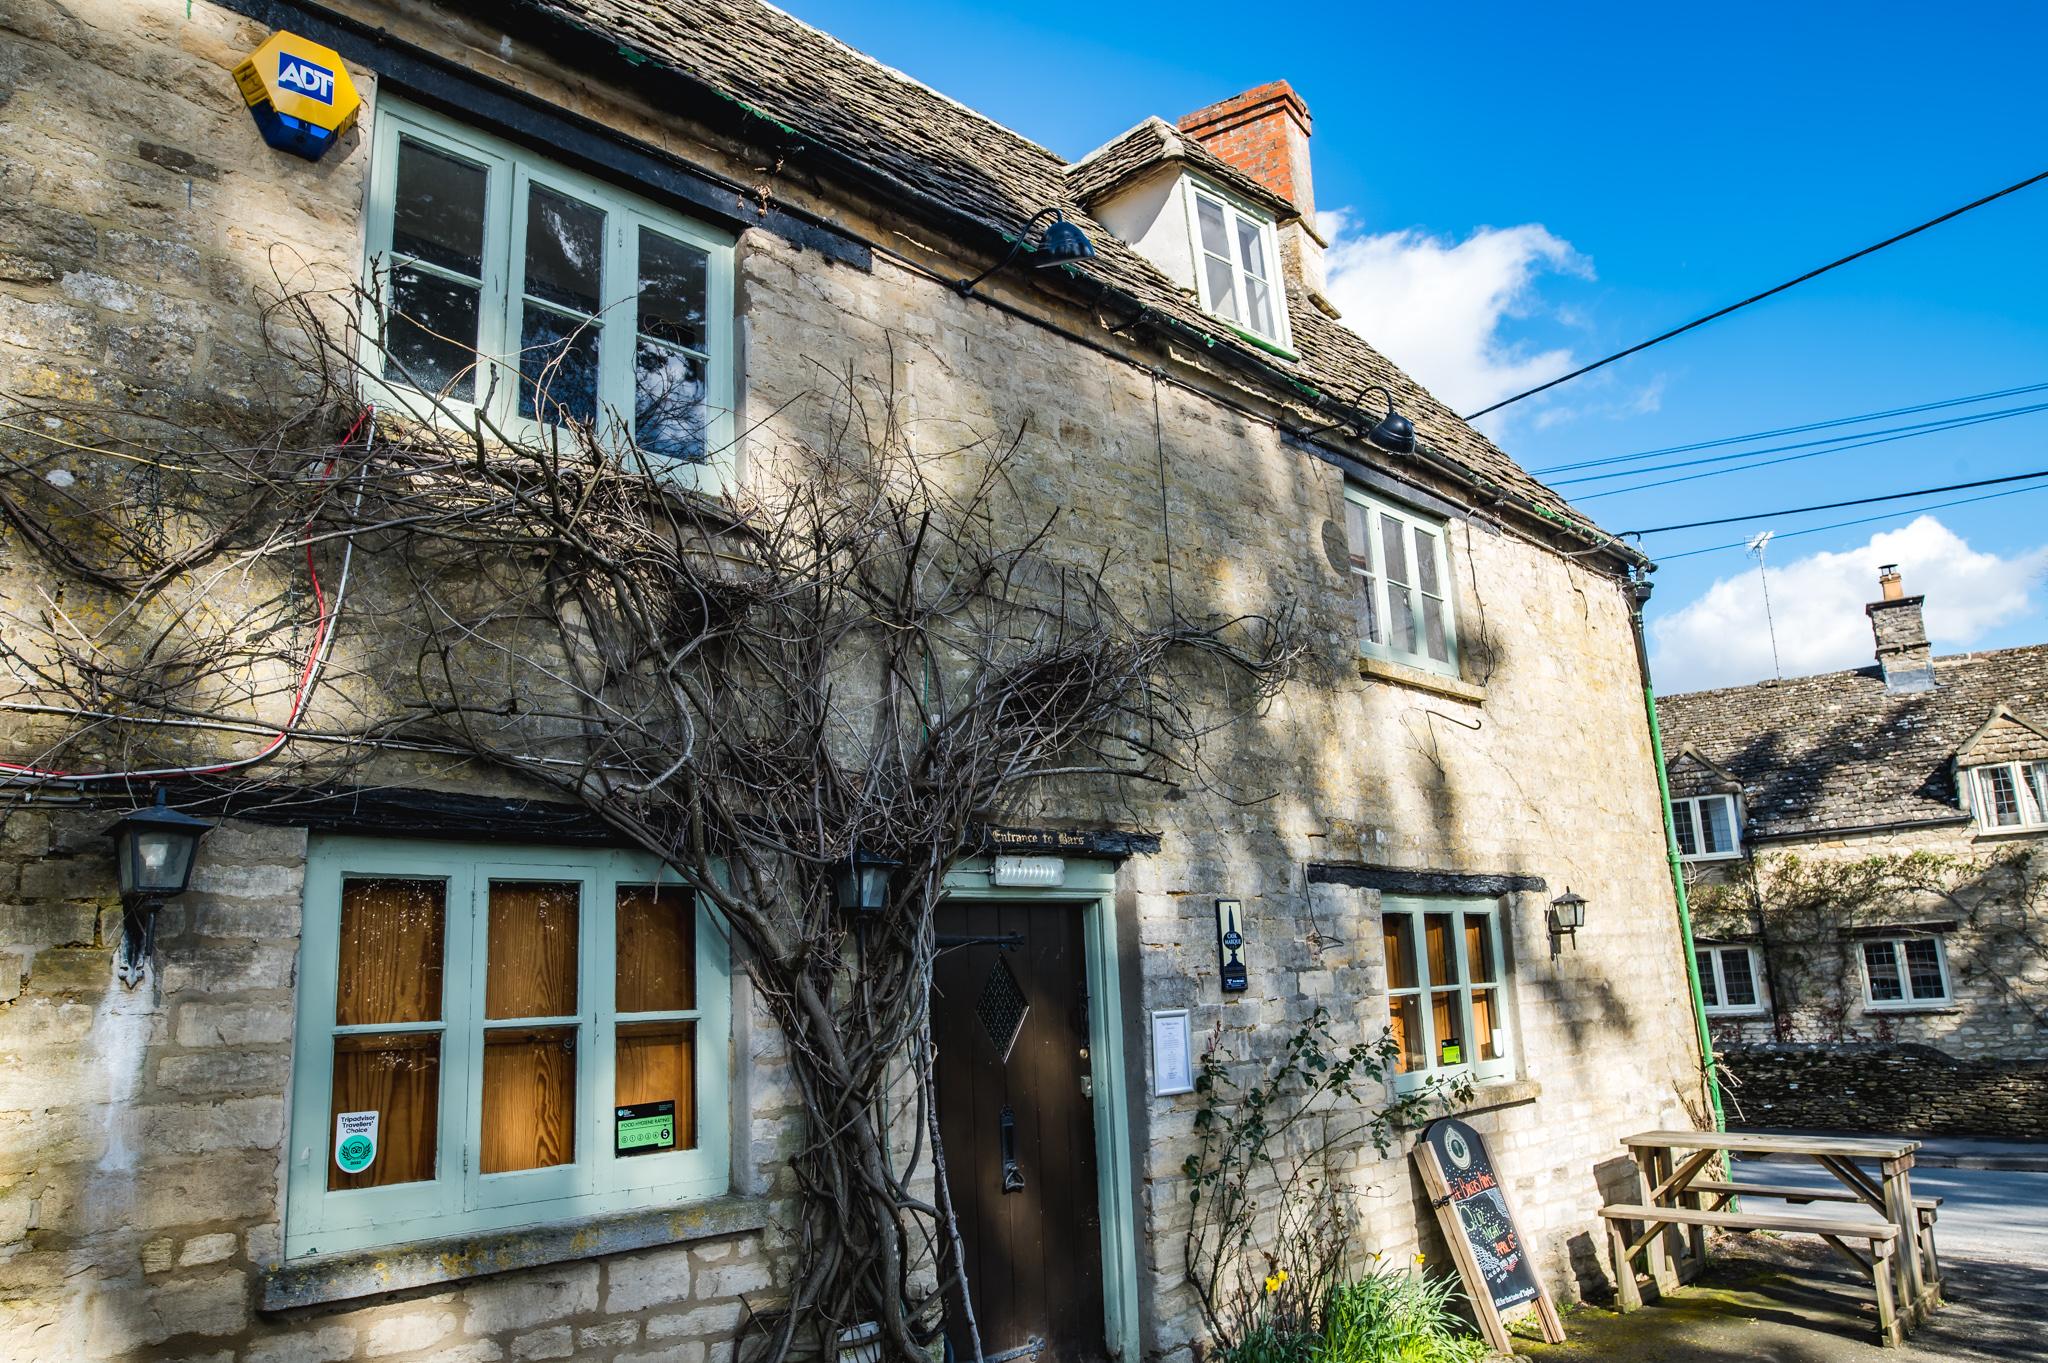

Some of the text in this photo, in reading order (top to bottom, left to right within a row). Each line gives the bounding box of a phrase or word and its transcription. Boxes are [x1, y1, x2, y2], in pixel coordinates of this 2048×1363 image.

[279, 62, 333, 97] ADT
[993, 830, 1085, 845] Entrance to Bars
[341, 1115, 376, 1123] Tripadvisor
[635, 1119, 654, 1127] HYGIENE
[662, 1130, 669, 1139] 5
